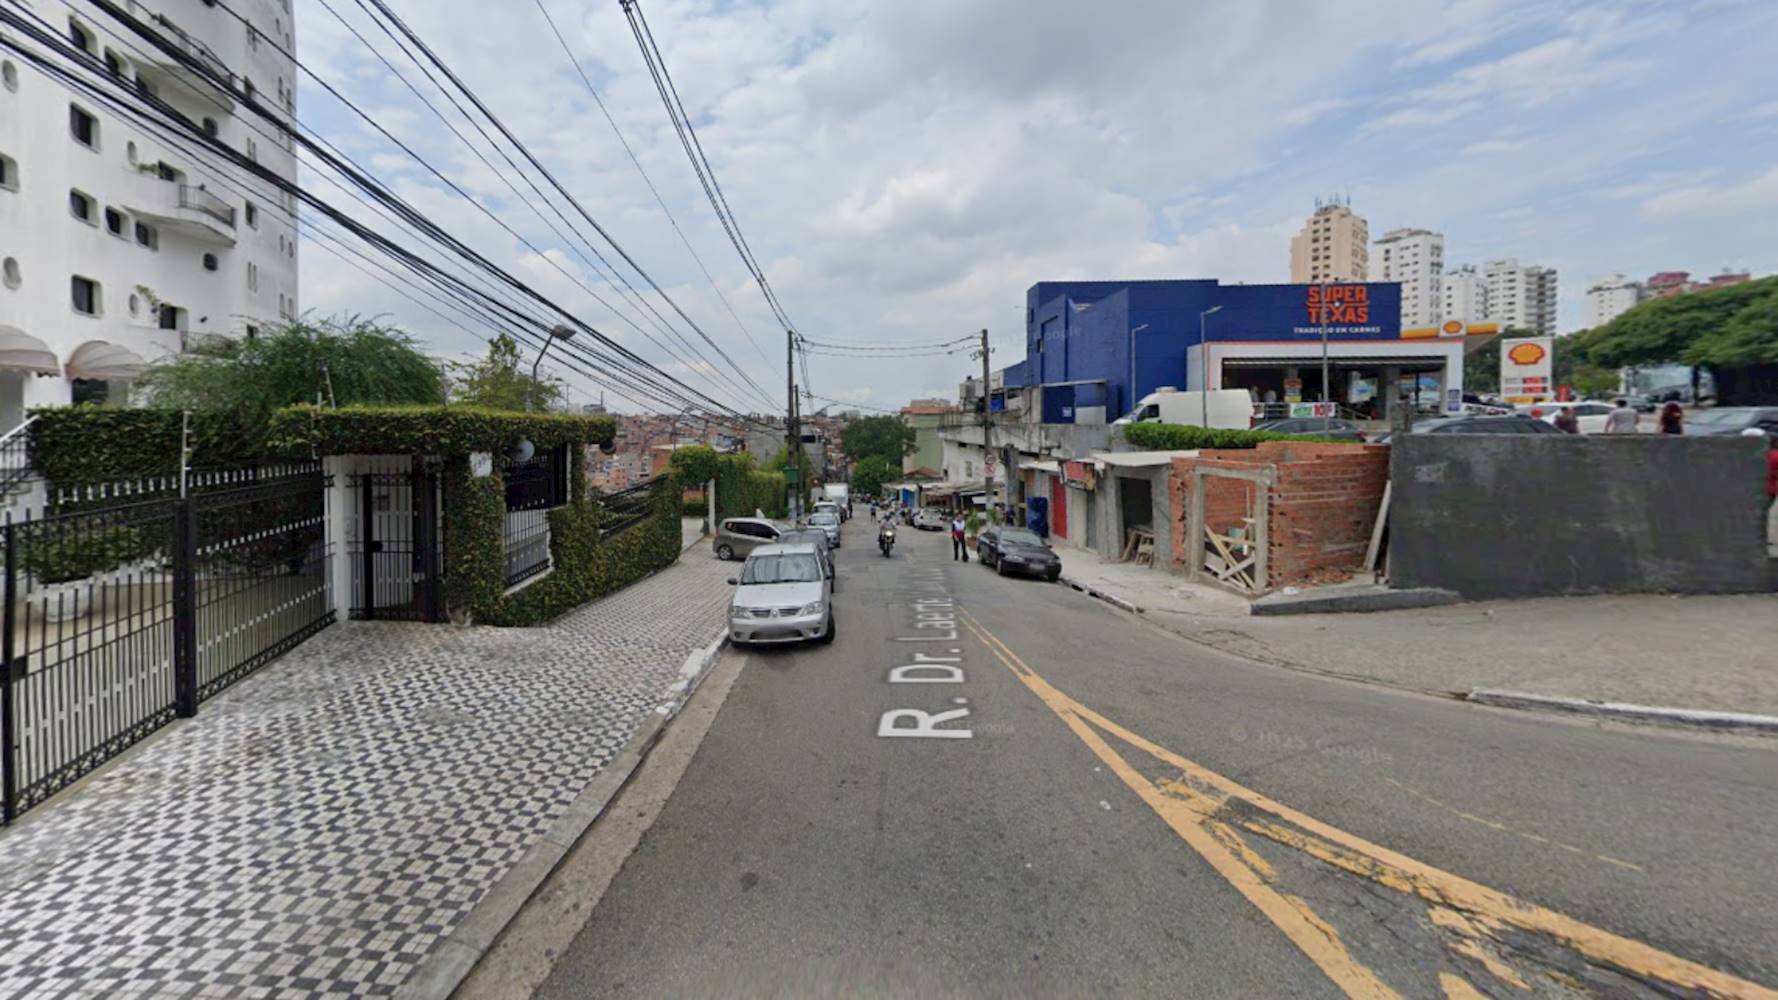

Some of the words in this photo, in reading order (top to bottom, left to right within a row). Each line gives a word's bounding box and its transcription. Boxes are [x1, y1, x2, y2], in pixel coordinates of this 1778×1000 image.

[1307, 287, 1367, 302] SUPER
[1308, 304, 1368, 323] TEXAS
[1293, 326, 1335, 335] TRADIÇO
[1349, 326, 1381, 334] CARNES
